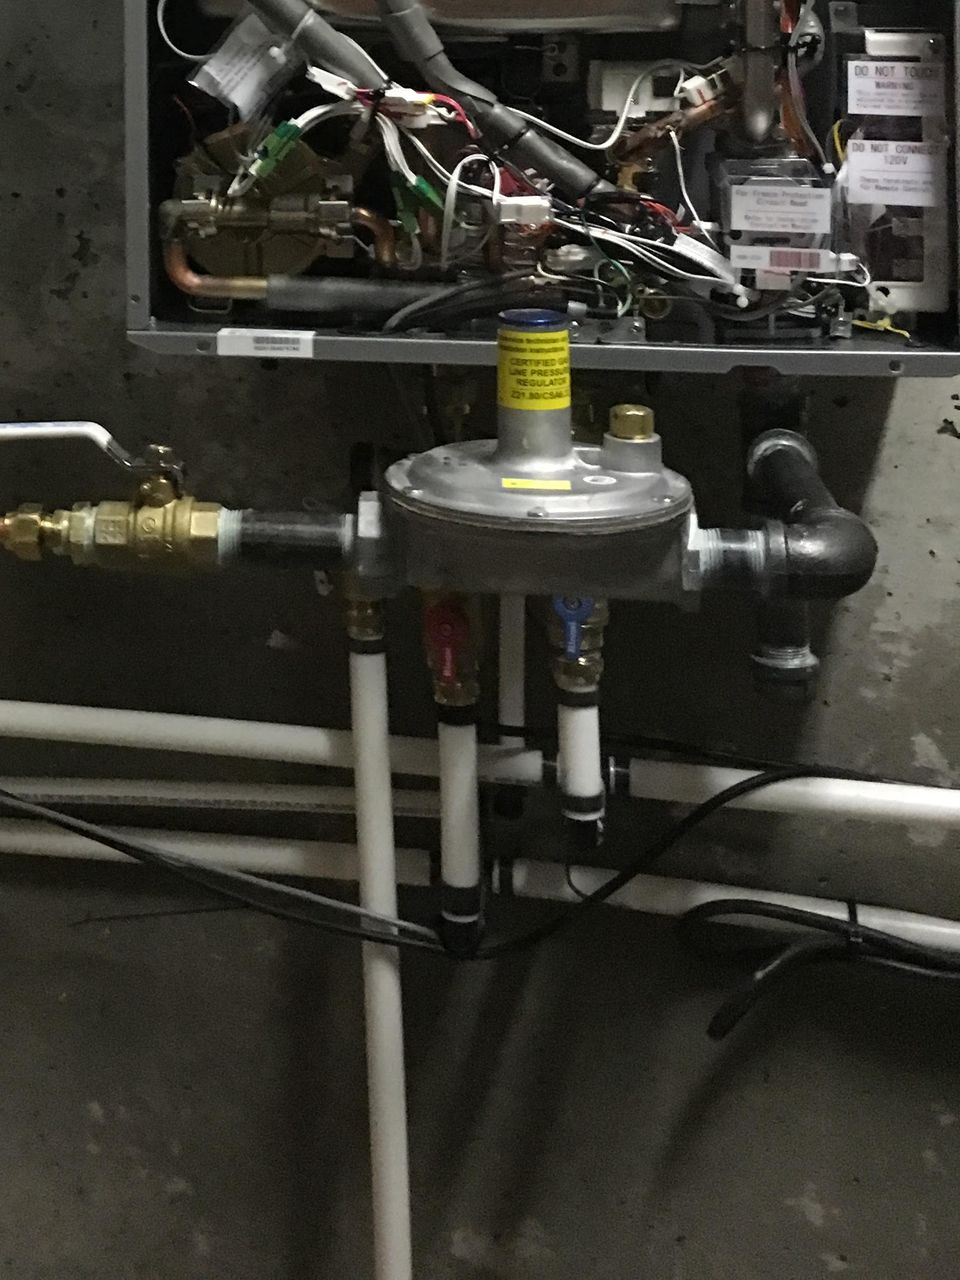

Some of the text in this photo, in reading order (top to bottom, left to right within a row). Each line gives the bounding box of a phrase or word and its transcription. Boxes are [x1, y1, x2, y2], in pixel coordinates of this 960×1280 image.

[854, 65, 869, 77] DO
[875, 65, 896, 78] NOT
[852, 142, 866, 153] DO
[871, 143, 889, 153] NOT
[510, 357, 556, 367] CERTIFIED
[509, 367, 527, 377] LINE
